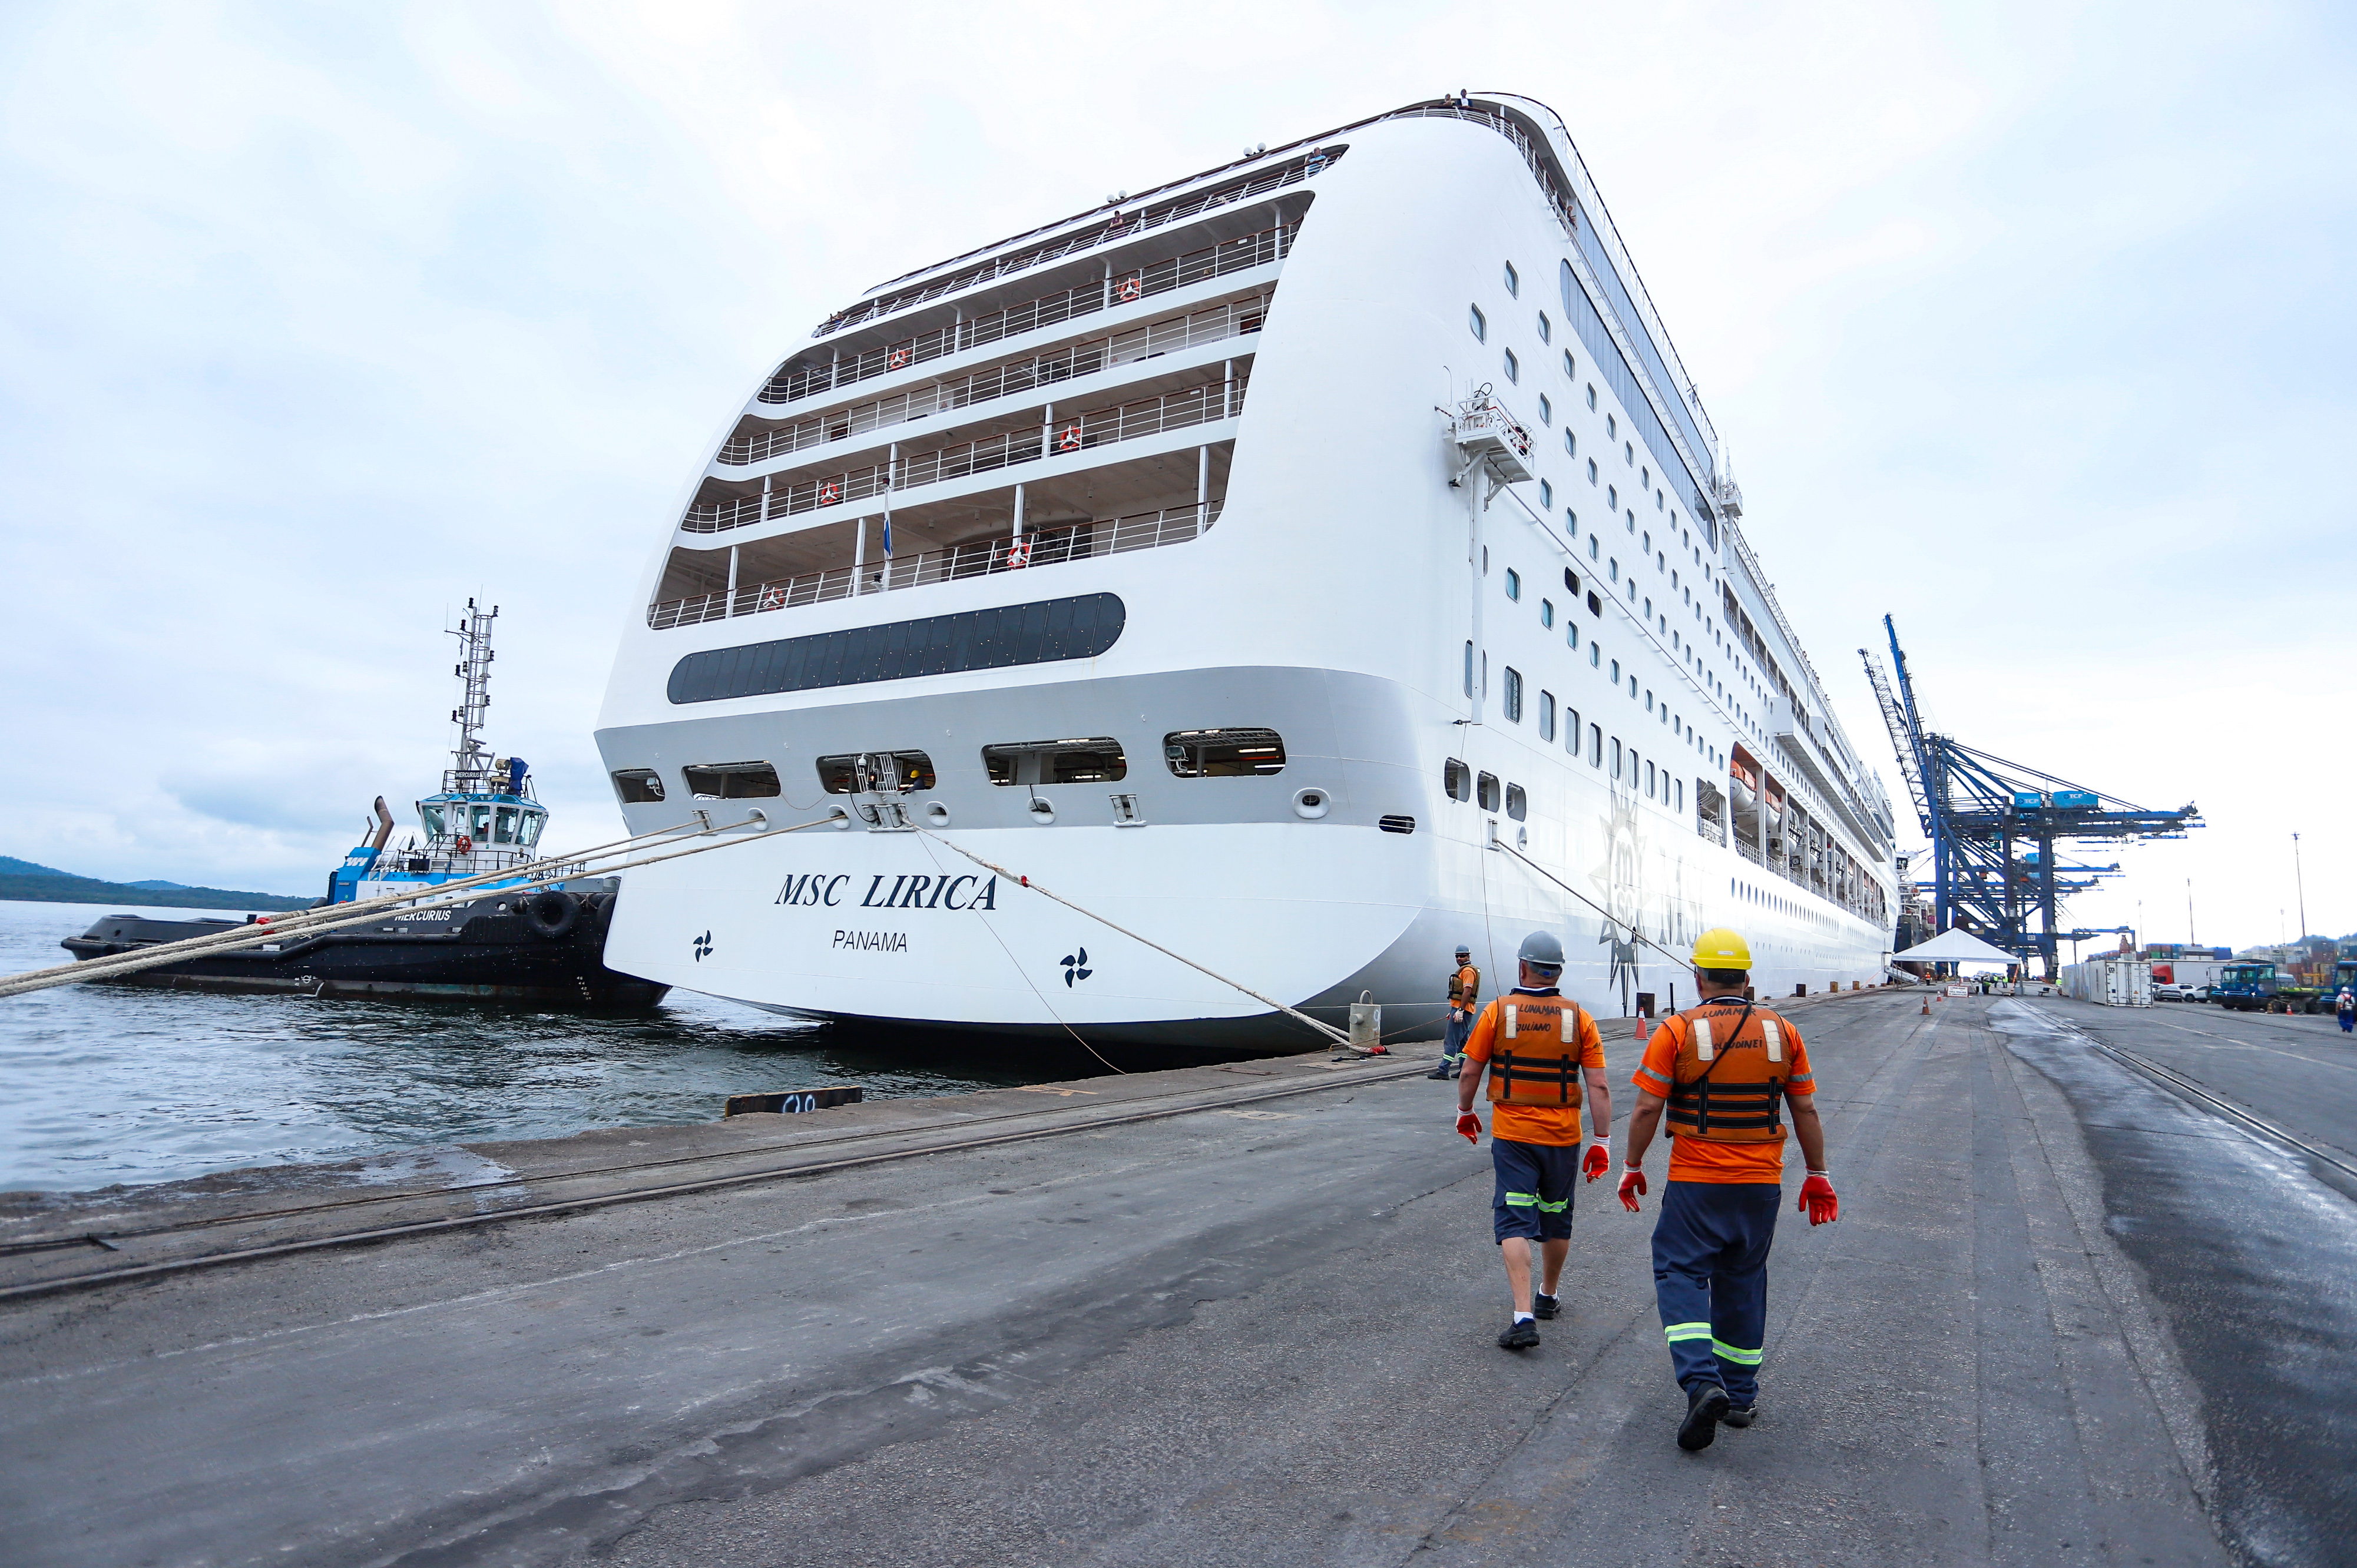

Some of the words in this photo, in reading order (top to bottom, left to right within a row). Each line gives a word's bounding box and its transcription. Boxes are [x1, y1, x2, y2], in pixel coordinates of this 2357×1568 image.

[1901, 679, 1909, 699] Terminal
[774, 874, 851, 907] MSC
[860, 874, 997, 910] LIRICA
[832, 930, 908, 953] PANAMA
[1519, 1003, 1561, 1016] LUNAMAR
